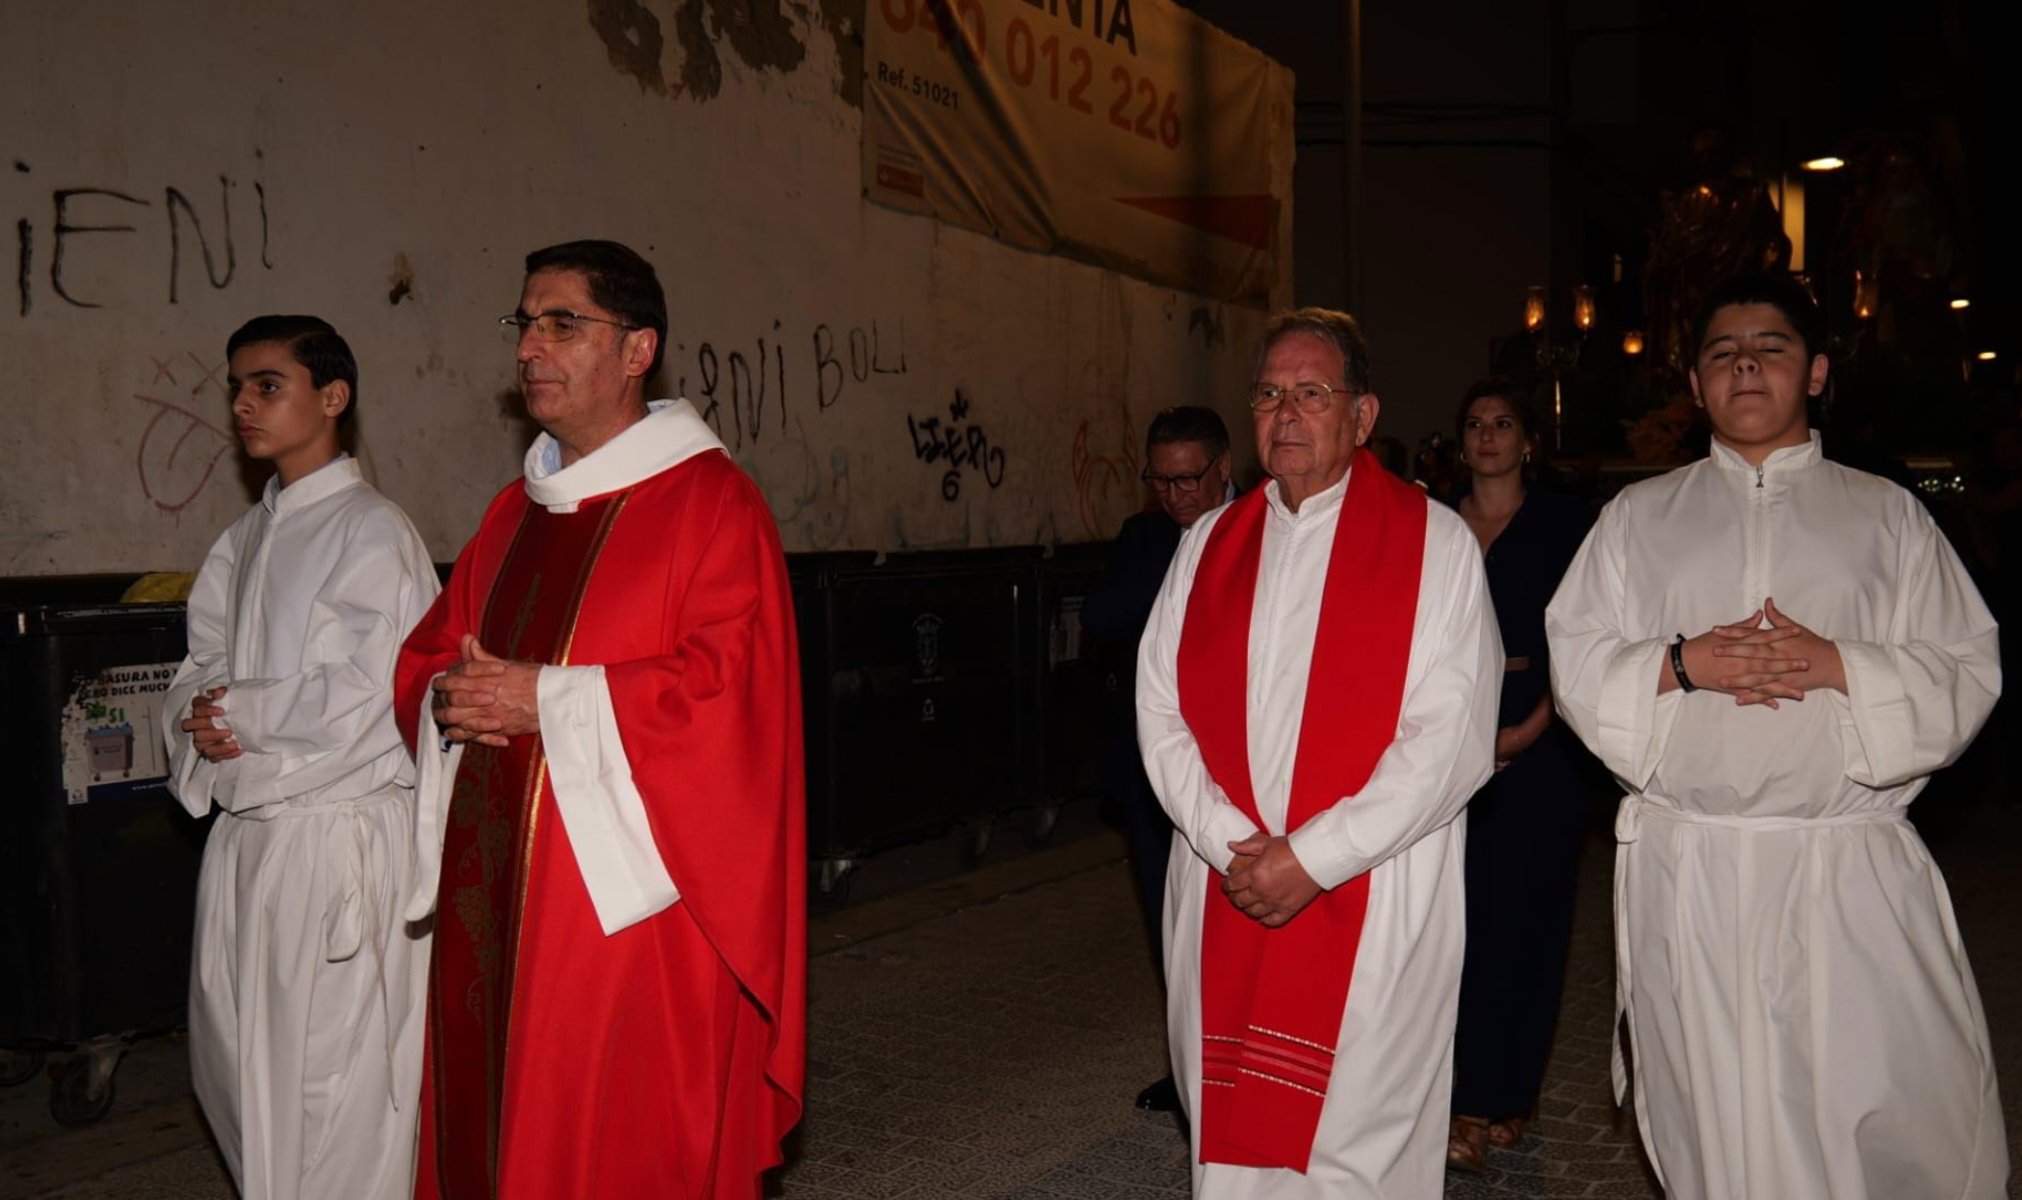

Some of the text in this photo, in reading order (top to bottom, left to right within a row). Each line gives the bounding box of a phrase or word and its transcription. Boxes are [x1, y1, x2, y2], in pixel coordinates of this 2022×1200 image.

[878, 61, 958, 111] Ref. 51021
[1006, 17, 1093, 115] 012
[1110, 66, 1181, 150] 226
[942, 470, 961, 501] 6
[153, 669, 170, 680] NO
[111, 685, 136, 696] DICE
